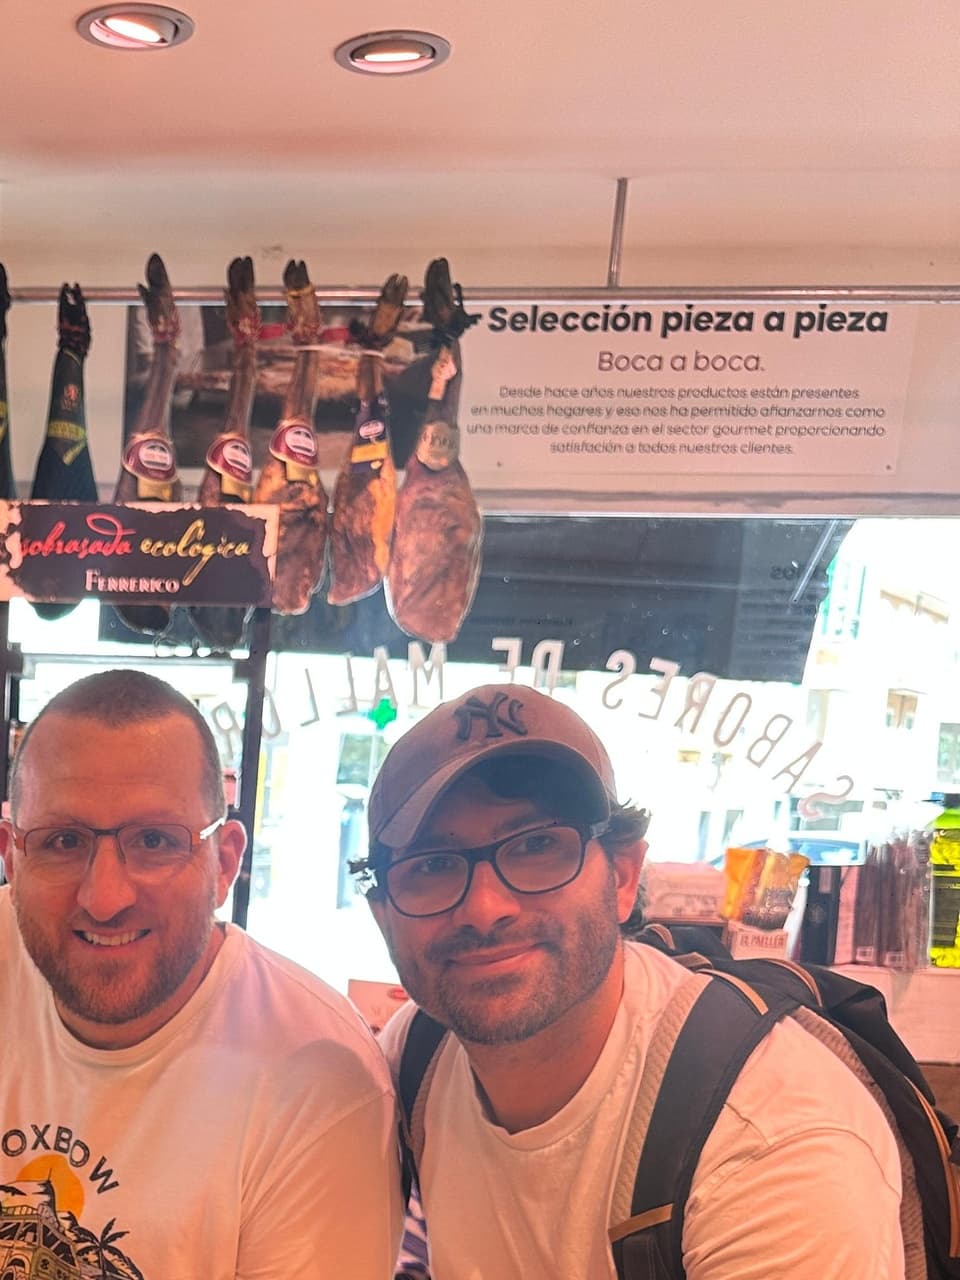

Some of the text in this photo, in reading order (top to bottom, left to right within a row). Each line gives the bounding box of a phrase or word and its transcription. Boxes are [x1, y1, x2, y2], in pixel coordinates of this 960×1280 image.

[487, 303, 889, 338] Selección pieza a pieza
[597, 350, 766, 372] Boca a boca.
[499, 385, 860, 401] Desde hace años nuestros productos están presentes
[470, 406, 488, 417] en
[490, 403, 544, 417] muchos
[546, 403, 604, 420] hogares
[604, 406, 613, 419] y
[643, 406, 668, 418] nos
[690, 404, 758, 420] permitido
[759, 404, 842, 418] afianzarnos
[845, 406, 886, 418] como
[466, 424, 493, 435] una
[495, 424, 540, 435] marca
[542, 422, 560, 436] de
[562, 422, 629, 437] confianza
[631, 424, 649, 435] en
[667, 423, 708, 437] sector
[712, 423, 773, 439] gourmet
[775, 422, 886, 439] proporcionando
[637, 441, 676, 455] todos
[678, 442, 737, 455] nuestros
[20, 512, 136, 560] sobrasada
[1, 1124, 120, 1195] OXBOW
